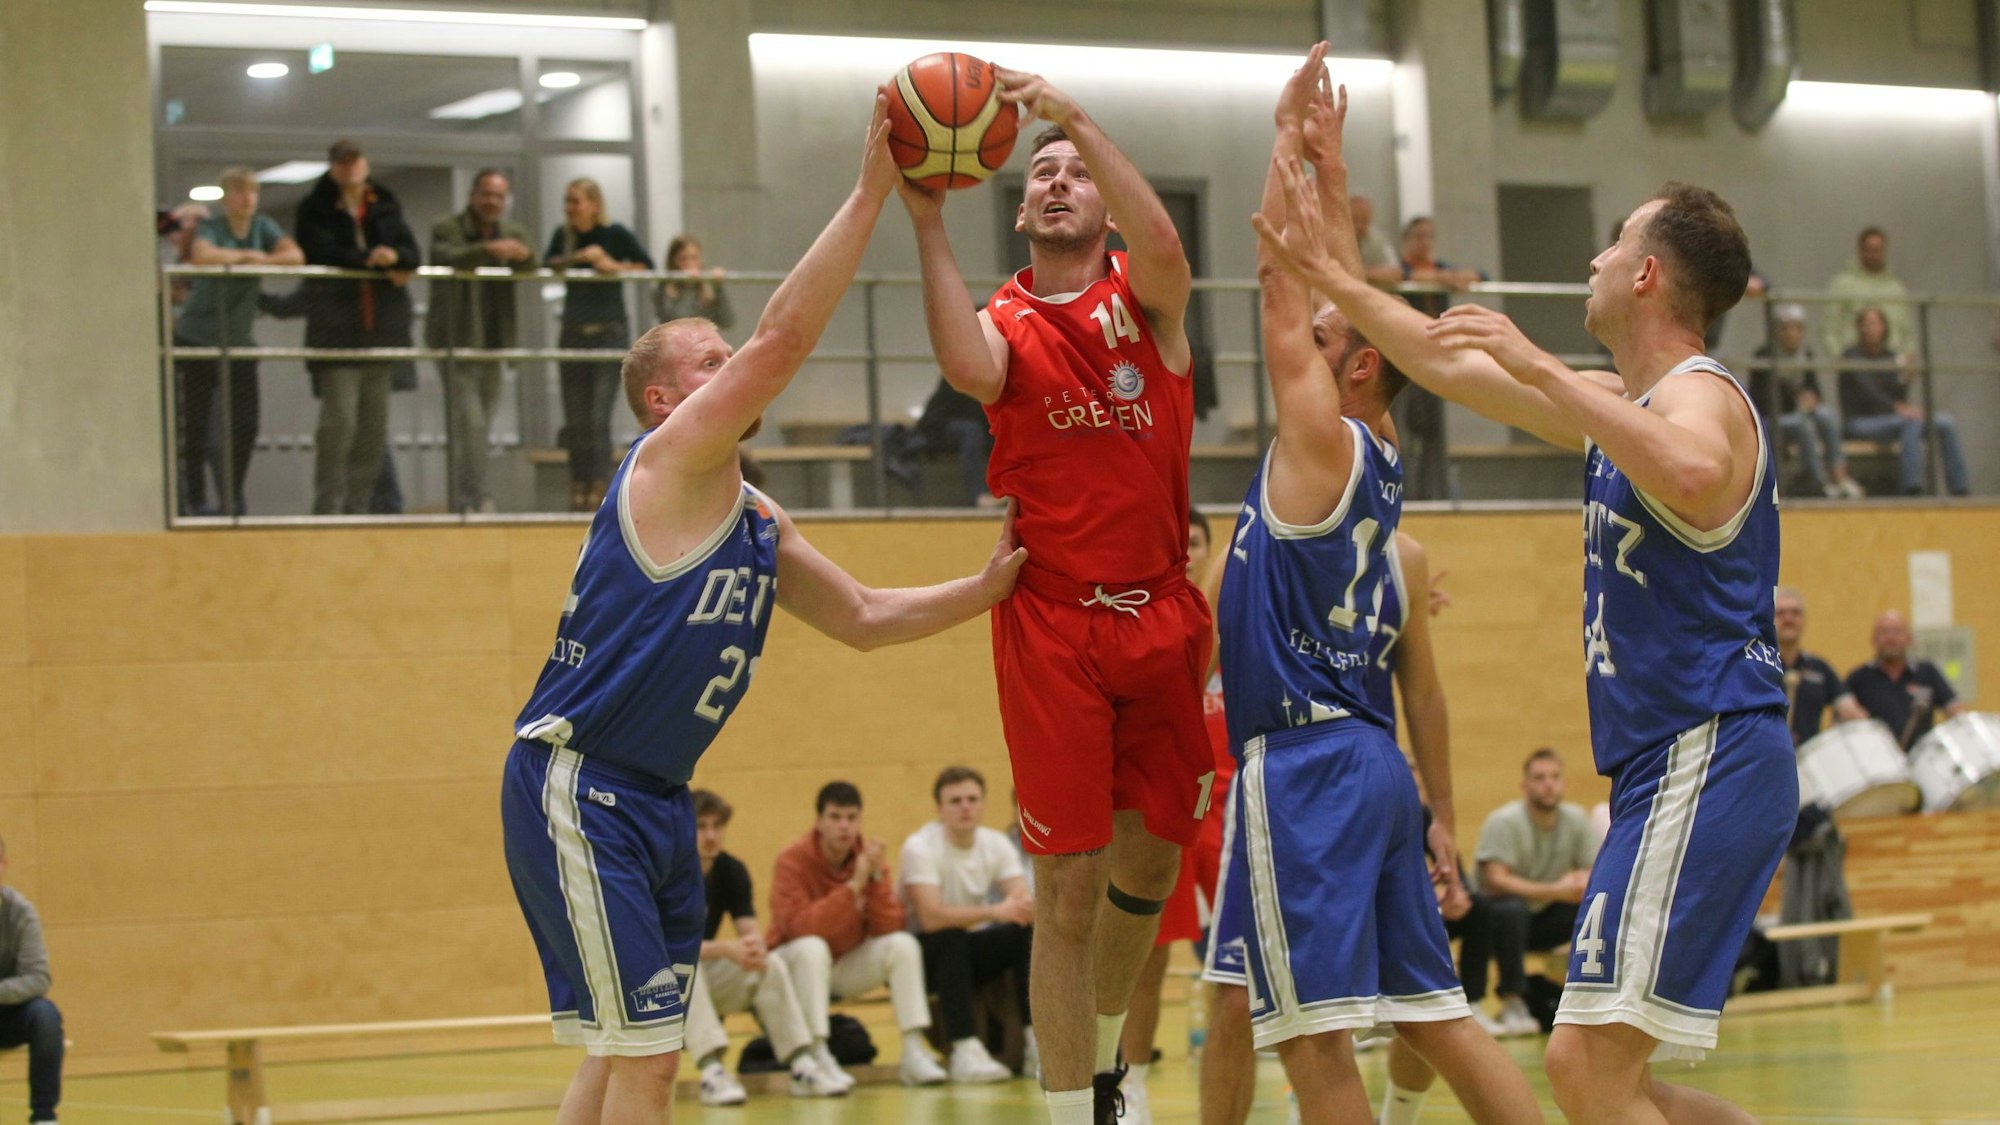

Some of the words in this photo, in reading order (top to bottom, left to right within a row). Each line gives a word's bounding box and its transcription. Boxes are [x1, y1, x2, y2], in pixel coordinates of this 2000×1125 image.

[1090, 293, 1141, 349] 14
[1044, 386, 1115, 408] PETER
[693, 645, 761, 724] 2
[1193, 771, 1216, 820] 1
[1023, 808, 1051, 836] SPALDING
[1575, 891, 1608, 977] 4
